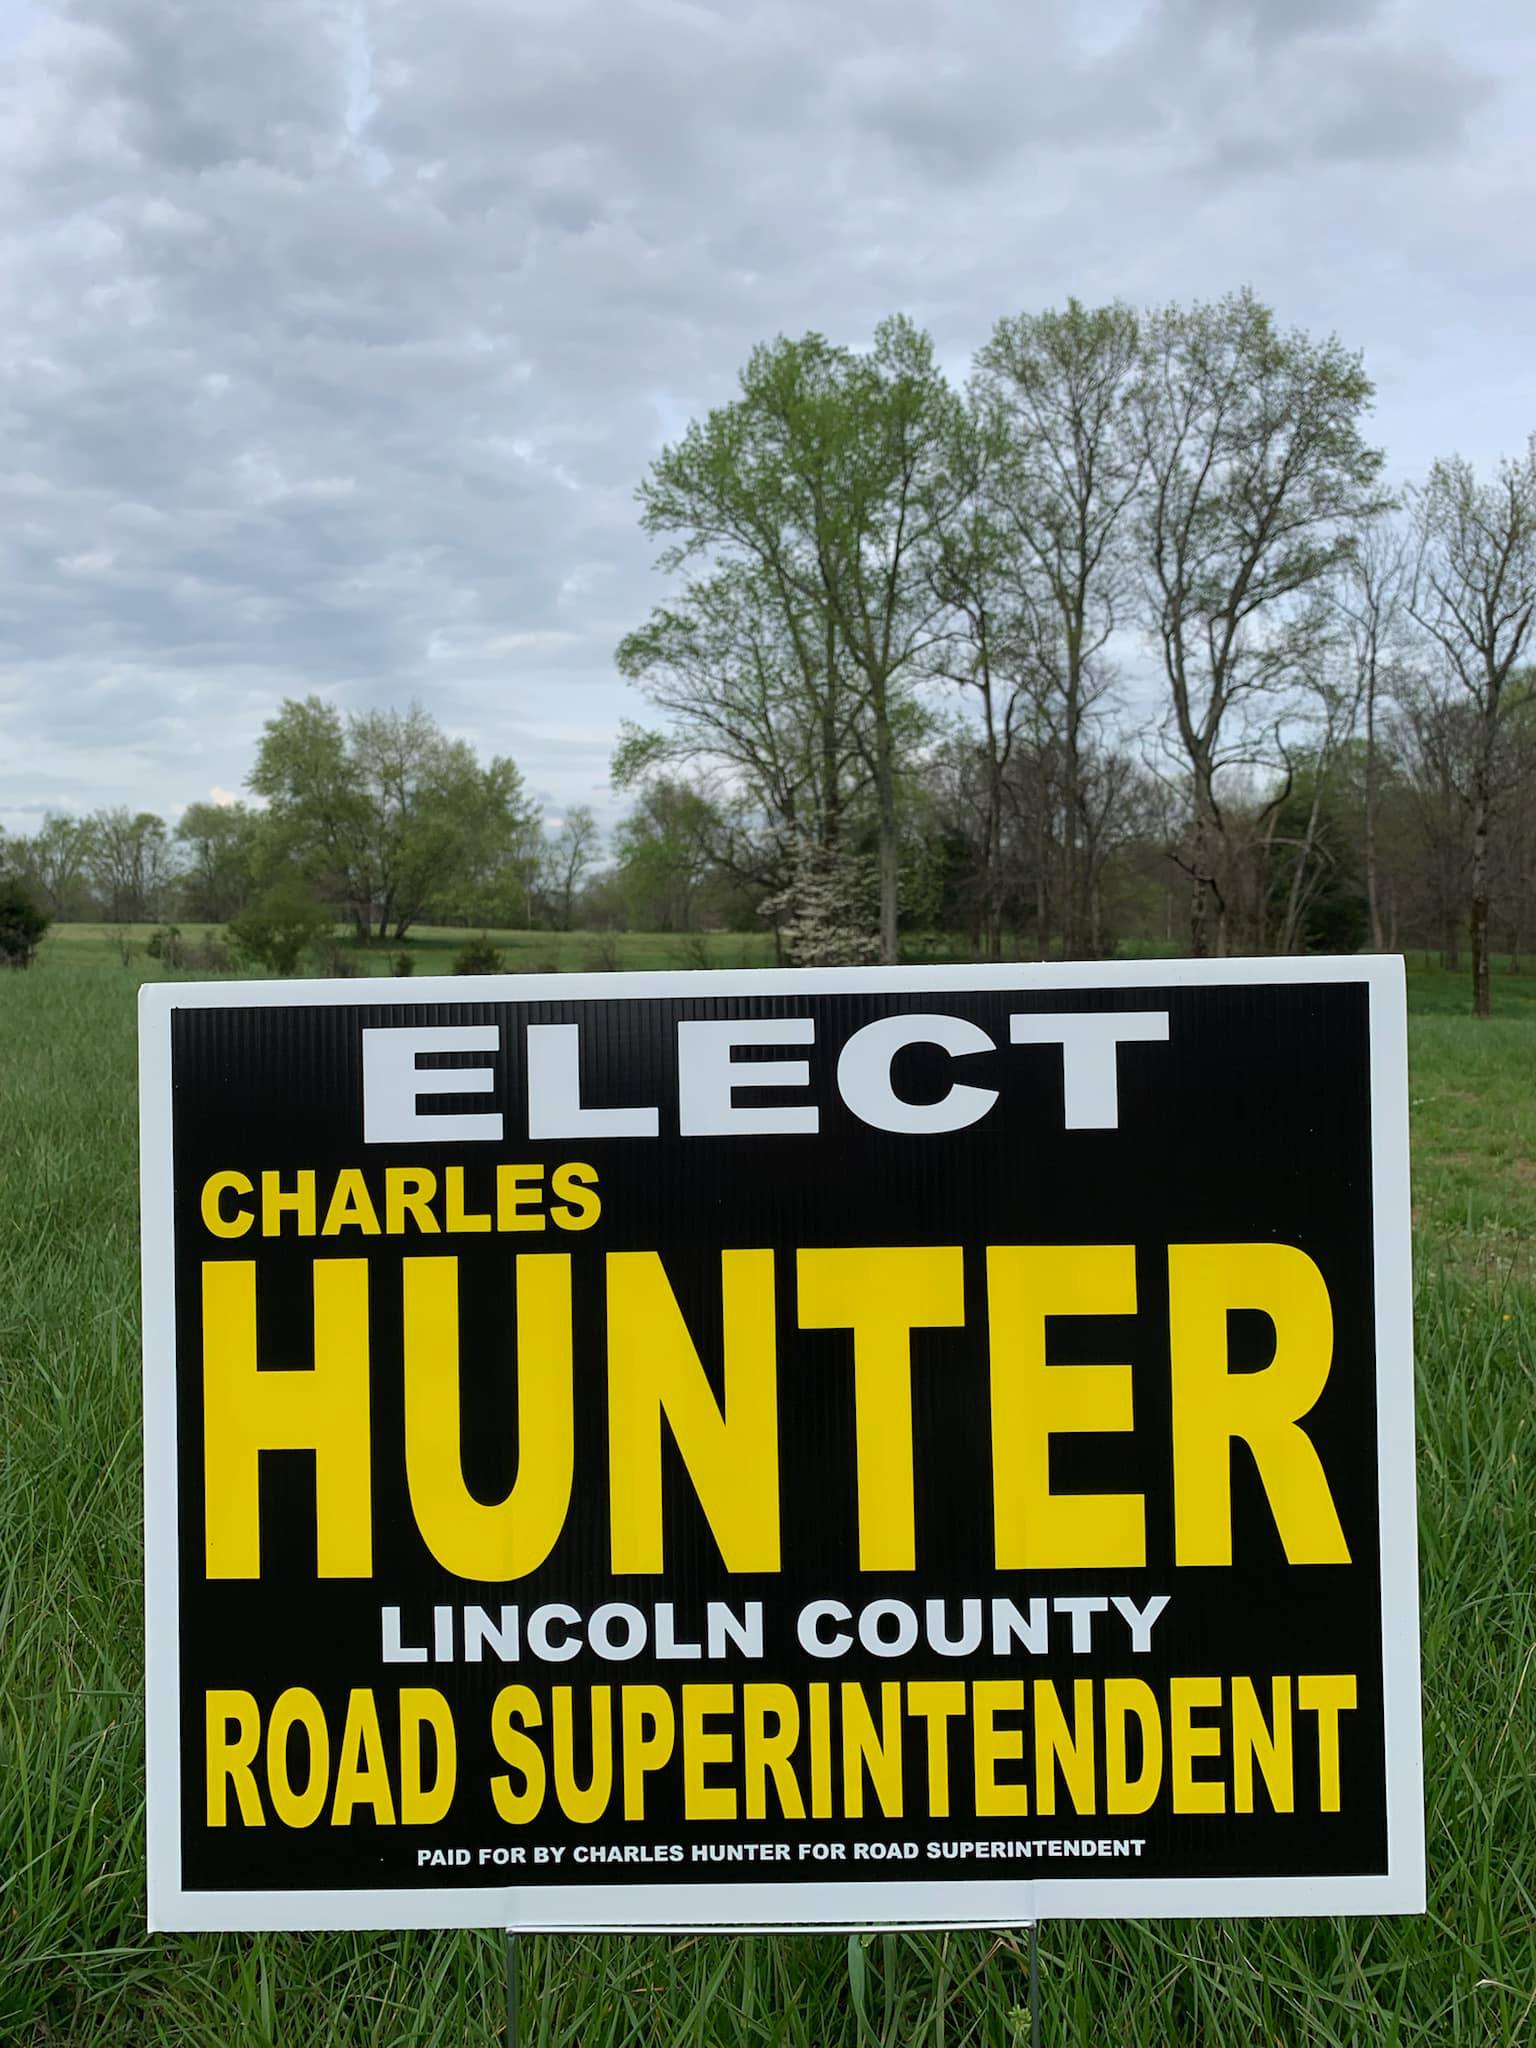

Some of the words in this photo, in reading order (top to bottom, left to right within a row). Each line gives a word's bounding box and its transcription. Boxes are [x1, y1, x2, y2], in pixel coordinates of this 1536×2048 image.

[362, 1011, 1170, 1144] ELECT
[200, 1162, 602, 1239] CHARLES
[201, 1242, 1353, 1583] HUNTER
[381, 1601, 764, 1663] LINCOLN
[797, 1595, 1172, 1659] COUNTY
[205, 1686, 457, 1829] ROAD
[490, 1674, 1359, 1825] SUPERINTENDENT
[417, 1848, 471, 1867] PAID
[478, 1847, 527, 1866] FOR
[533, 1846, 566, 1864] BY
[573, 1844, 685, 1863] CHARLES
[691, 1843, 791, 1862] HUNTER
[798, 1843, 847, 1861] FOR
[853, 1842, 919, 1860] ROAD
[926, 1839, 1146, 1859] SUPERINTENDENT
